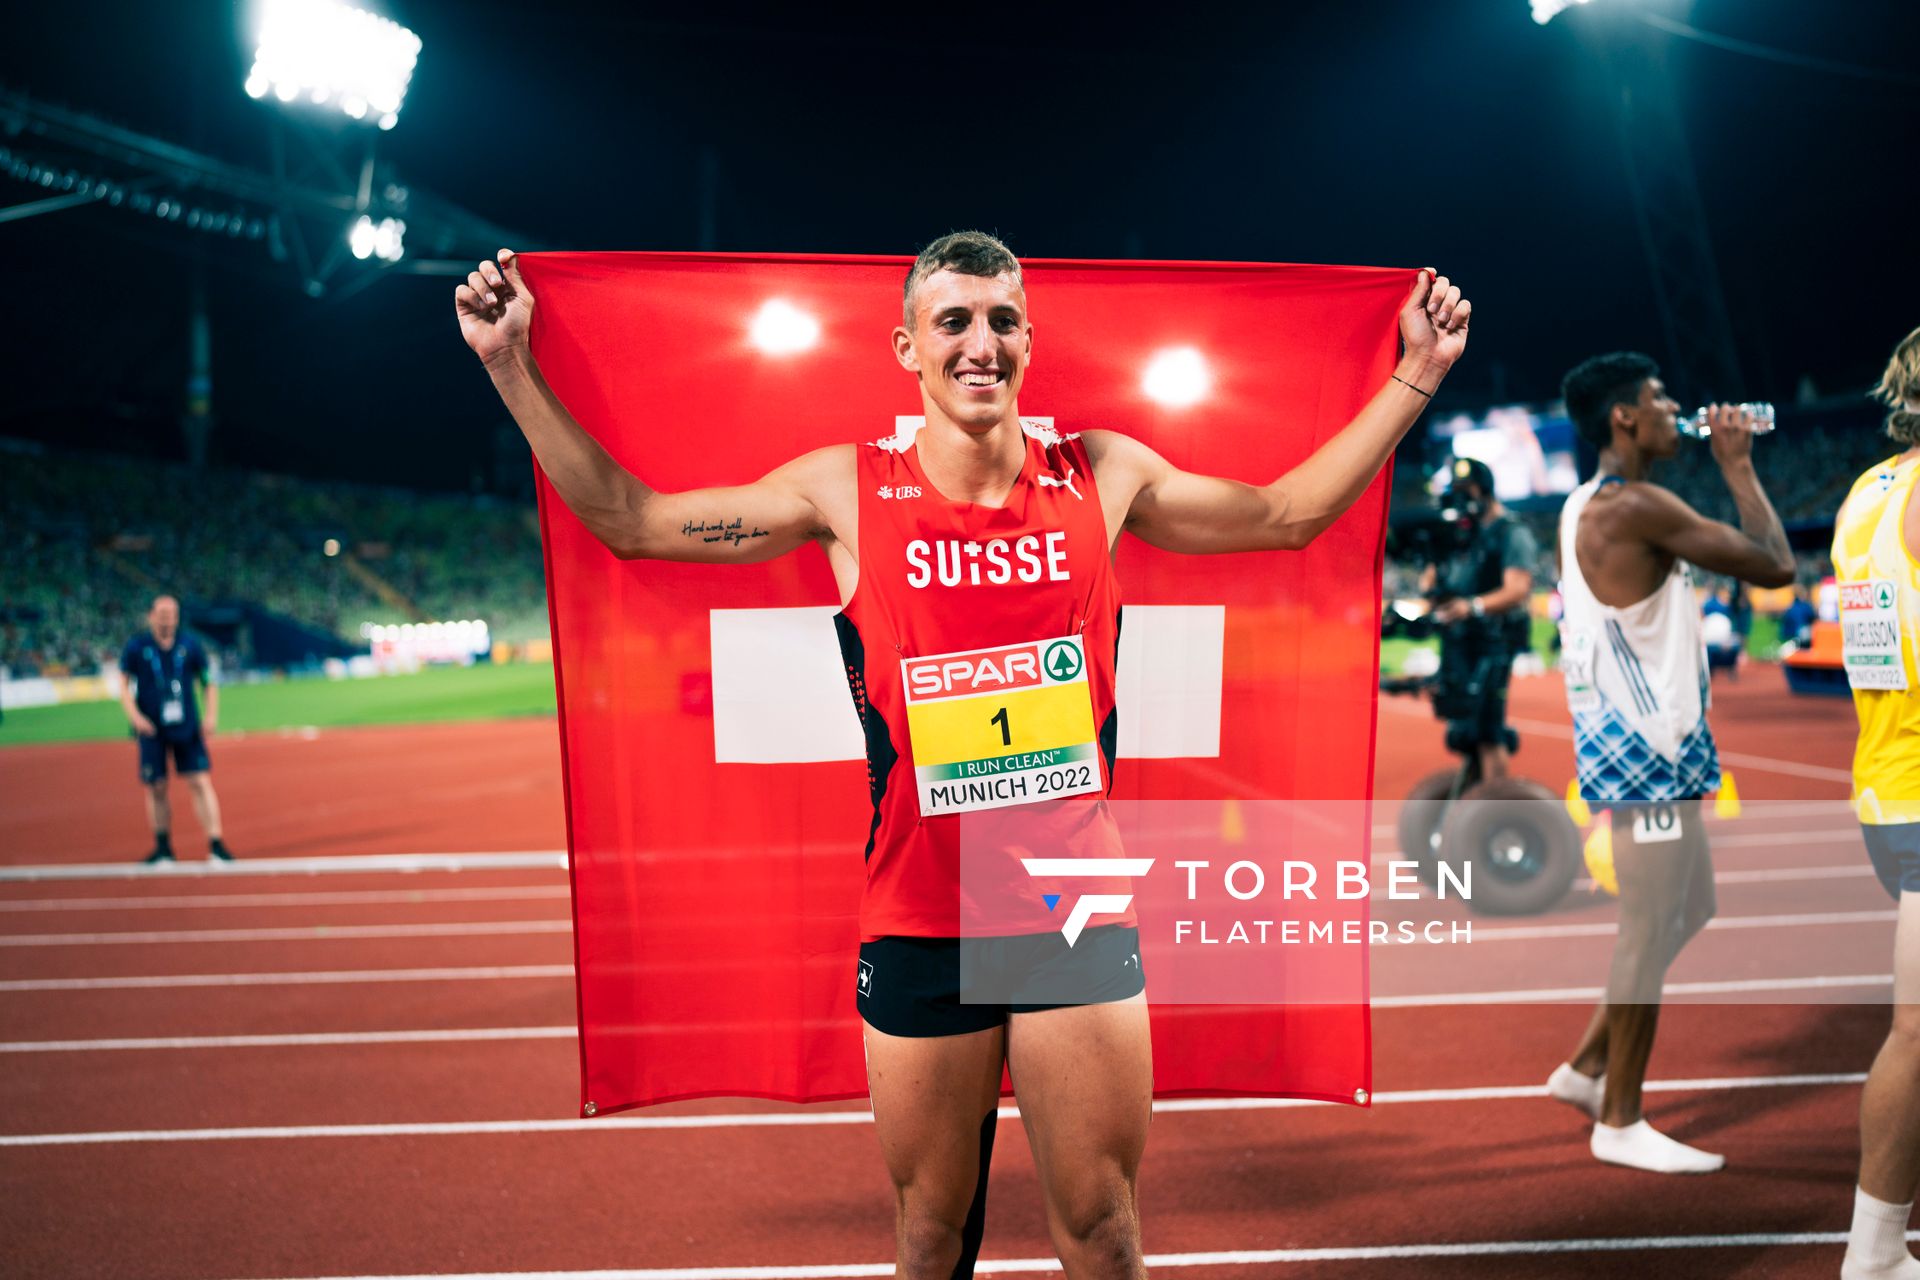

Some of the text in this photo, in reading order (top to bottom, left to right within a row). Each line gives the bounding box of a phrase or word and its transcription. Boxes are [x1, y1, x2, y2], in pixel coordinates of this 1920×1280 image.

[896, 486, 922, 499] UBS
[682, 520, 704, 536] Hard
[727, 518, 742, 529] will
[906, 532, 1071, 588] SUISSE
[910, 651, 1039, 695] SPAR
[990, 707, 1012, 746] 1
[958, 764, 963, 776] I
[968, 759, 1000, 776] RUN
[930, 766, 1092, 808] MUNICH 2022
[1641, 805, 1674, 832] 10
